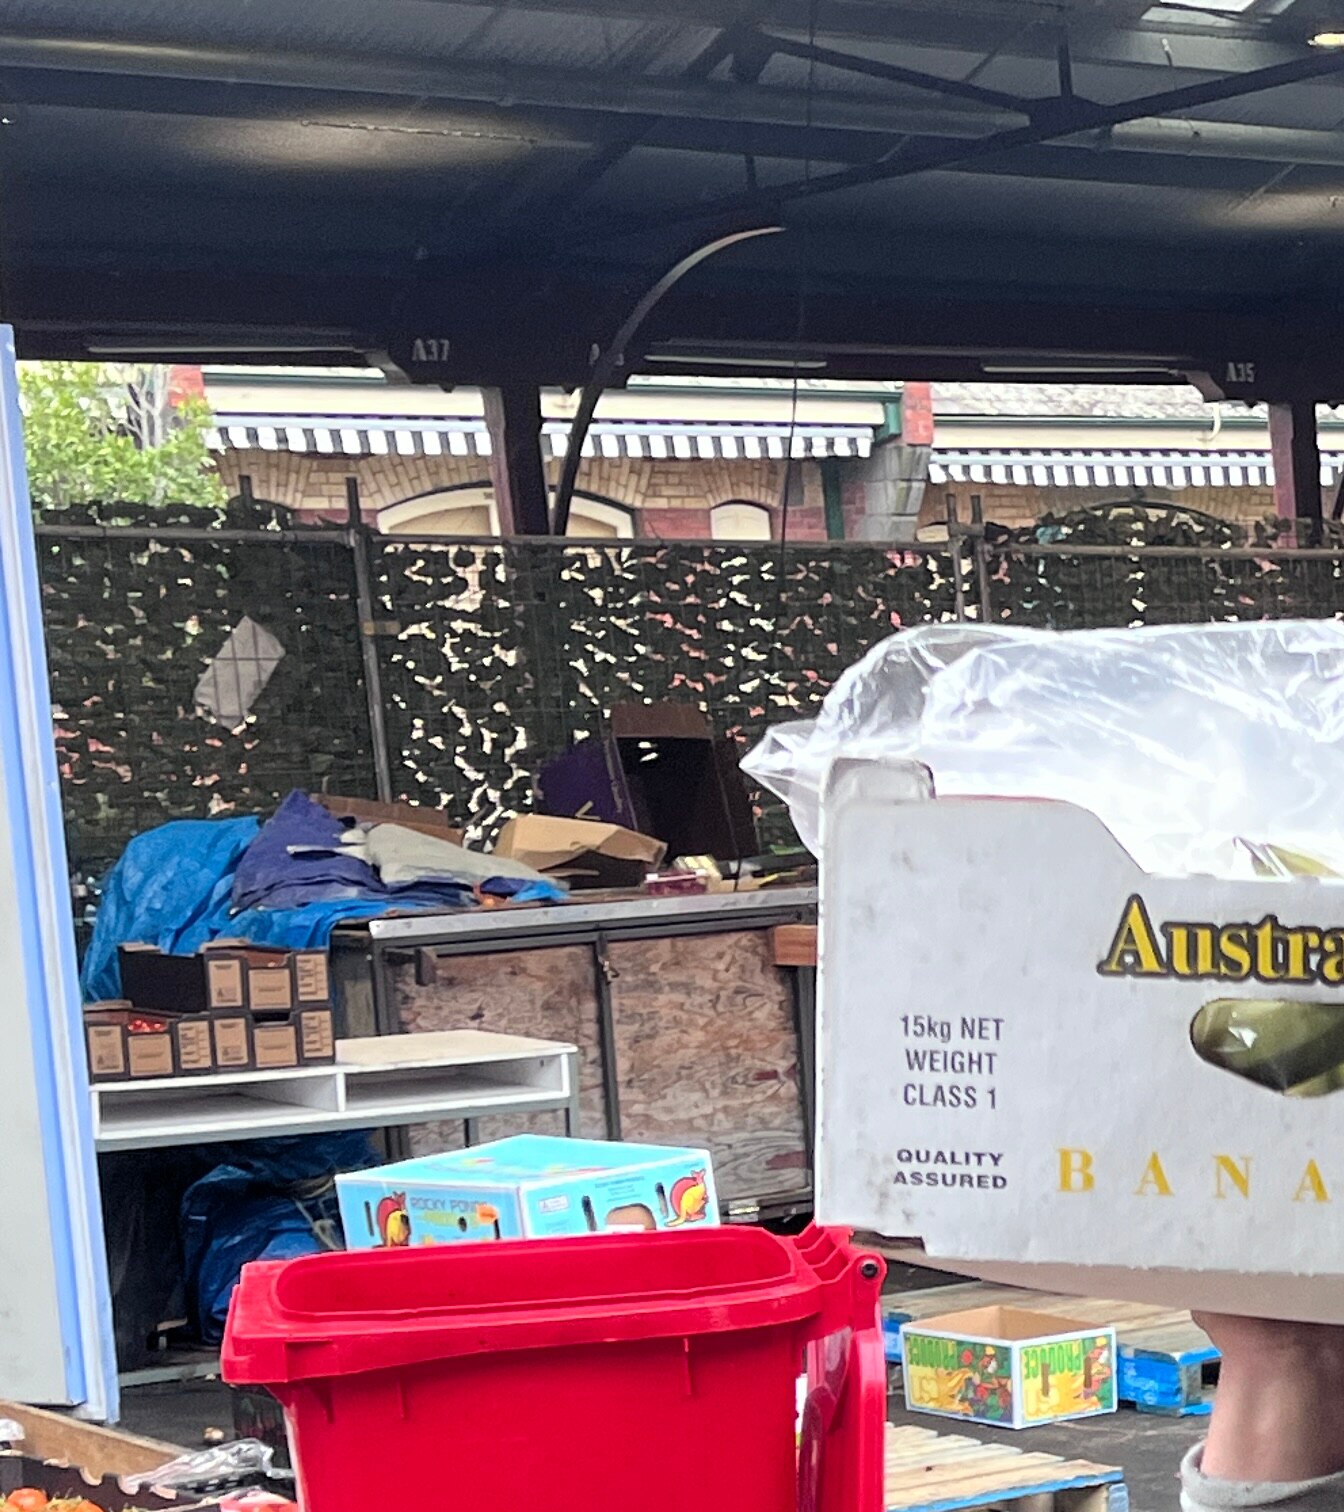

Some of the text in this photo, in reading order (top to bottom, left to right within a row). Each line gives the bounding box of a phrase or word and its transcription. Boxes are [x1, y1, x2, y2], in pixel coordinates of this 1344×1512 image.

[412, 338, 449, 361] A37
[1226, 362, 1255, 383] A35
[901, 1015, 1005, 1043] 15kg NET
[905, 1048, 998, 1075] WEIGHT
[903, 1083, 997, 1110] CLASS 1
[896, 1149, 1004, 1167] QUALITY
[893, 1170, 1008, 1190] ASSURED
